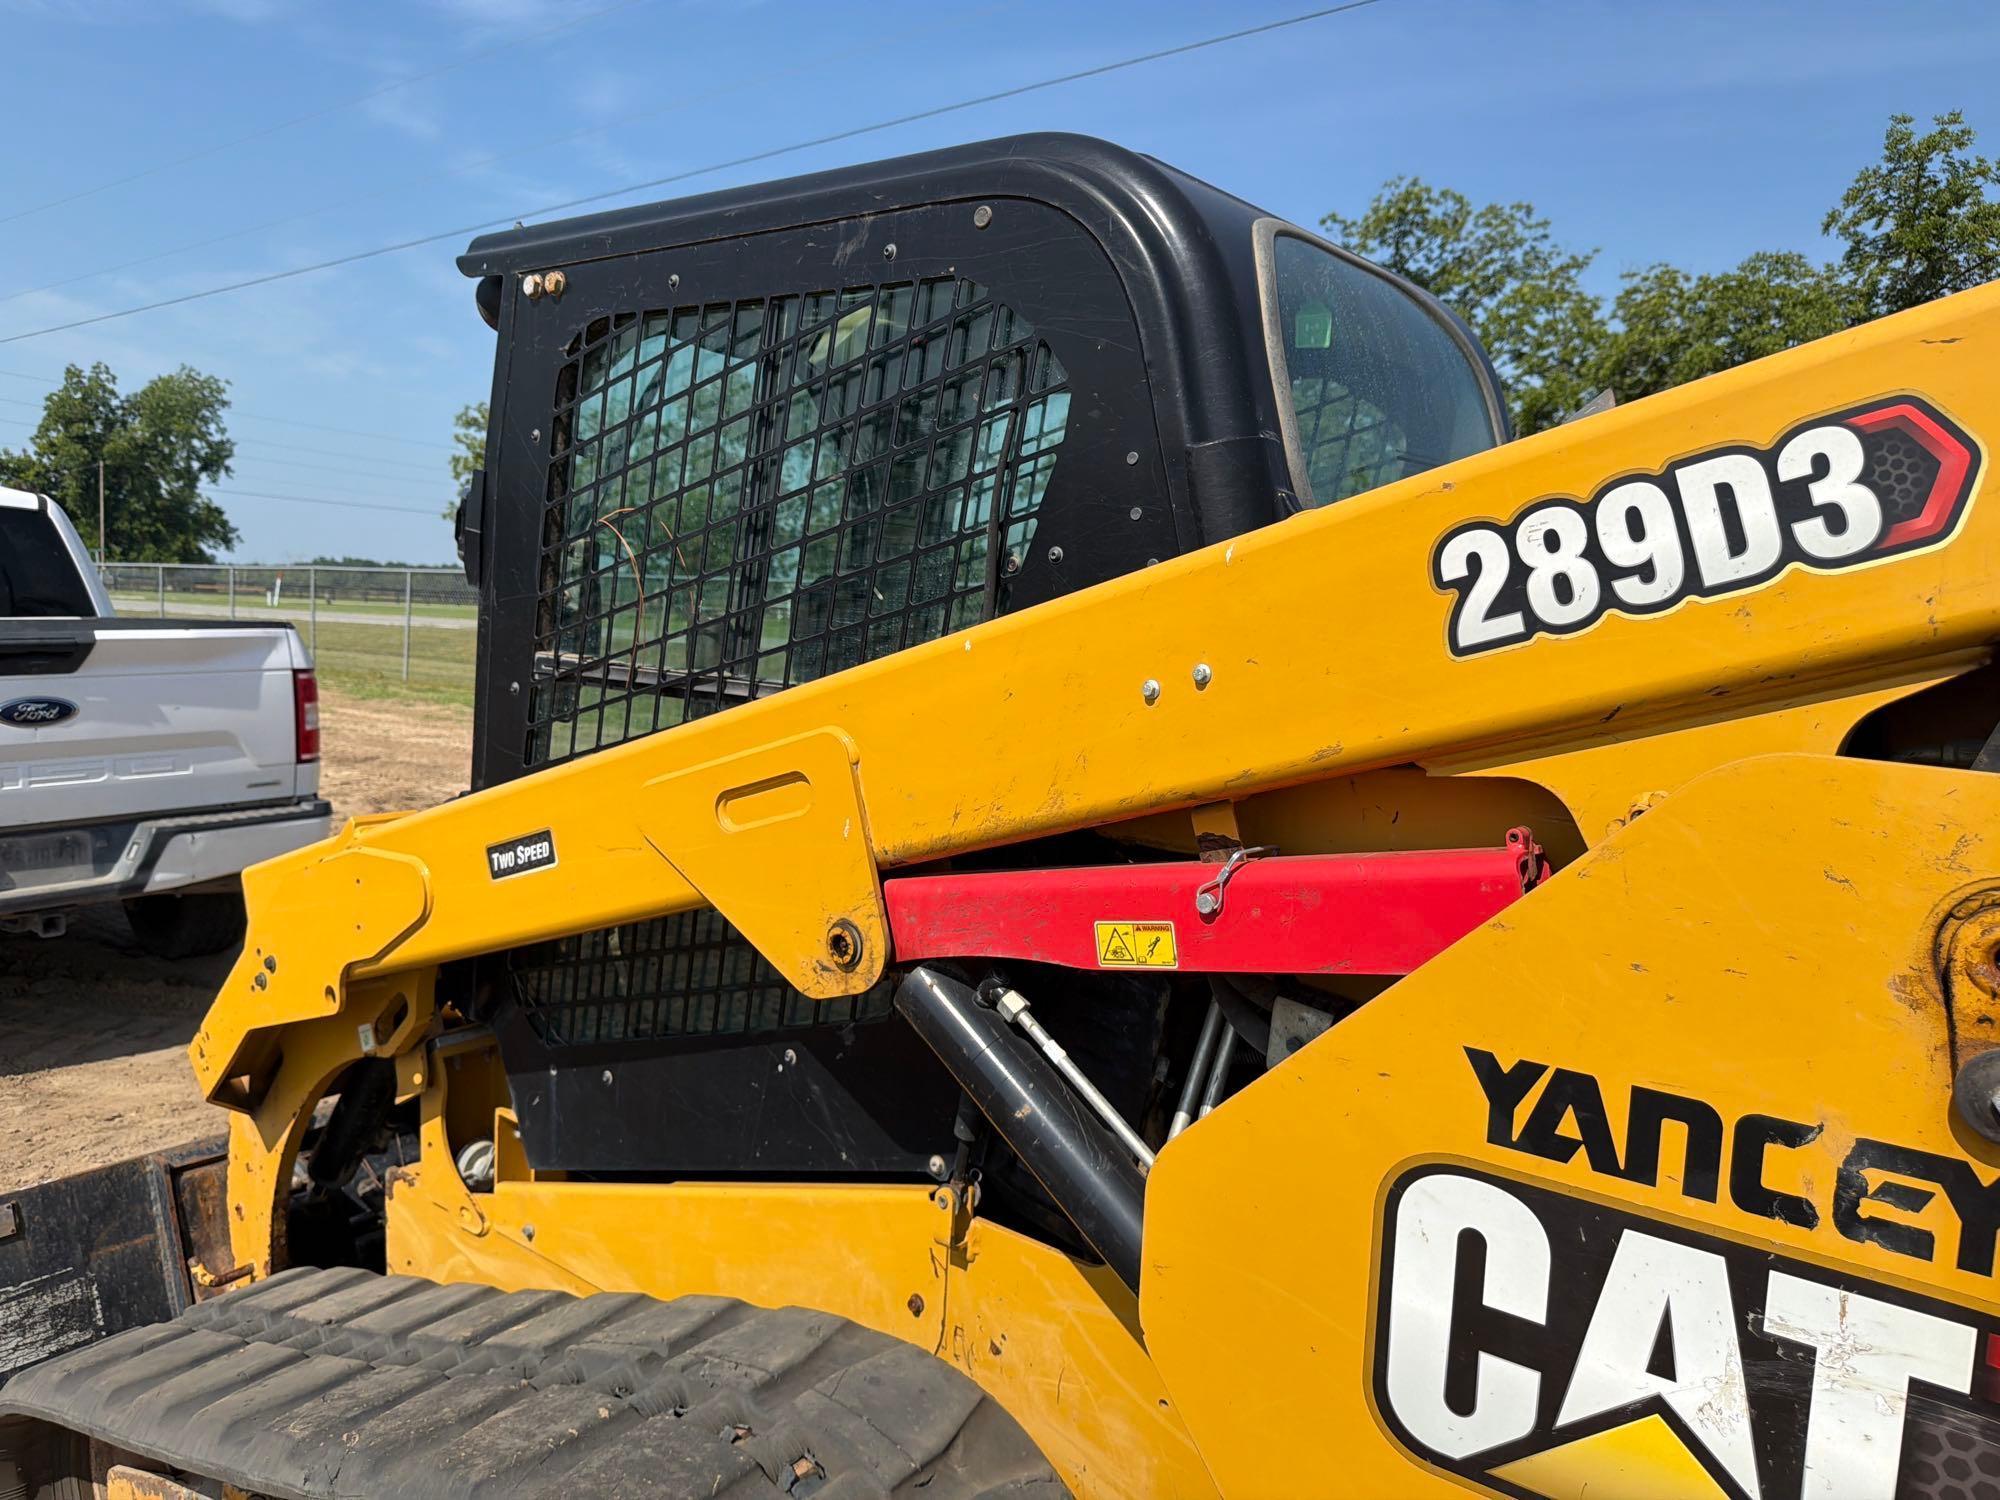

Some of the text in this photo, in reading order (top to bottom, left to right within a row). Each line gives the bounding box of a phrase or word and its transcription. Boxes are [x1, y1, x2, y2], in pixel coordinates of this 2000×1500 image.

[1440, 426, 1882, 648] 289D3
[13, 702, 60, 721] Ford
[492, 841, 549, 871] TWO SPEED
[1463, 1046, 2000, 1277] YANCEY
[1387, 1174, 1978, 1500] CAT
